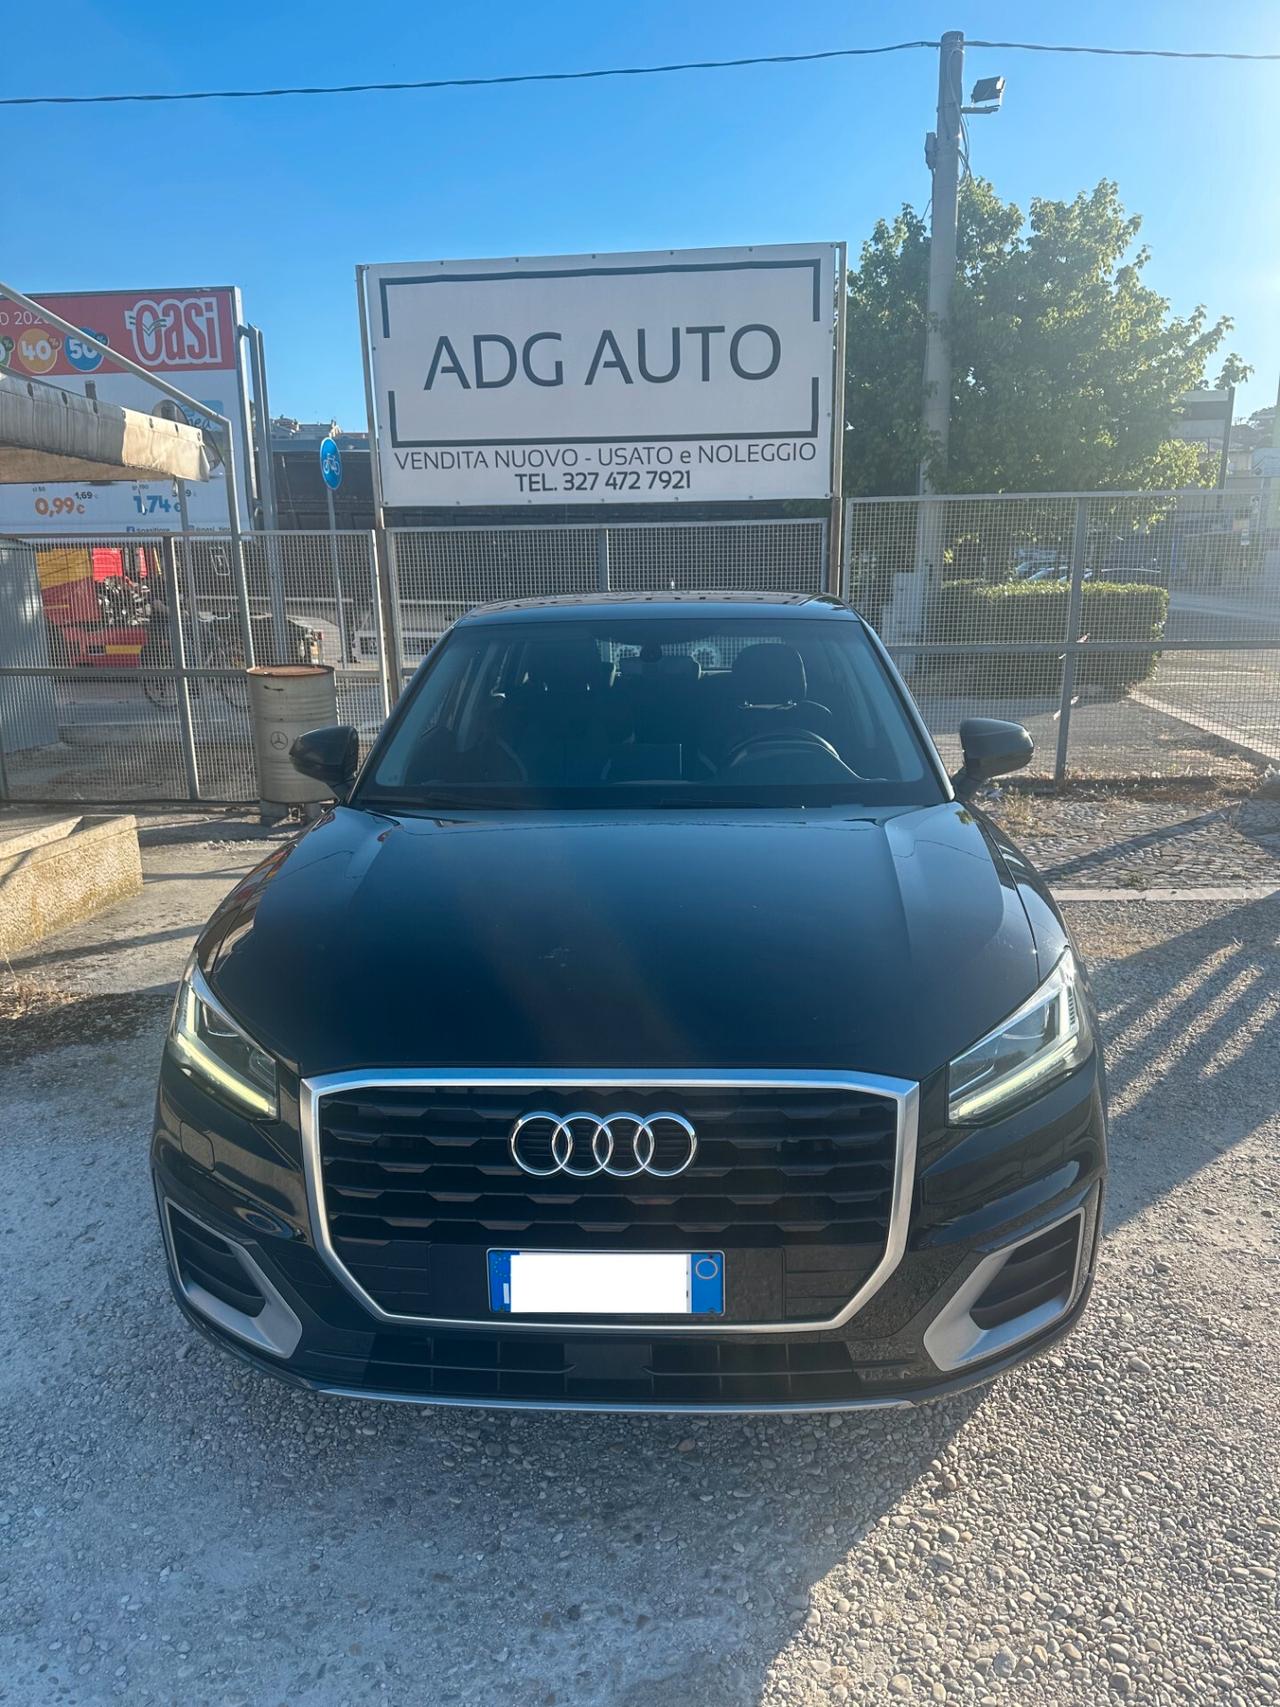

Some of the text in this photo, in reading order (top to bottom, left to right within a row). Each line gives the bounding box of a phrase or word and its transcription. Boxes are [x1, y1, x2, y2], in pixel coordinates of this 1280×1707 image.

[423, 323, 782, 391] ADG AUTO
[394, 450, 489, 470] VENDITA
[495, 448, 578, 469] NUOVO
[598, 446, 673, 466] USATO
[680, 450, 692, 464] e
[699, 442, 817, 464] NOLEGGIO
[514, 470, 691, 492] TEL. 327 472 7921
